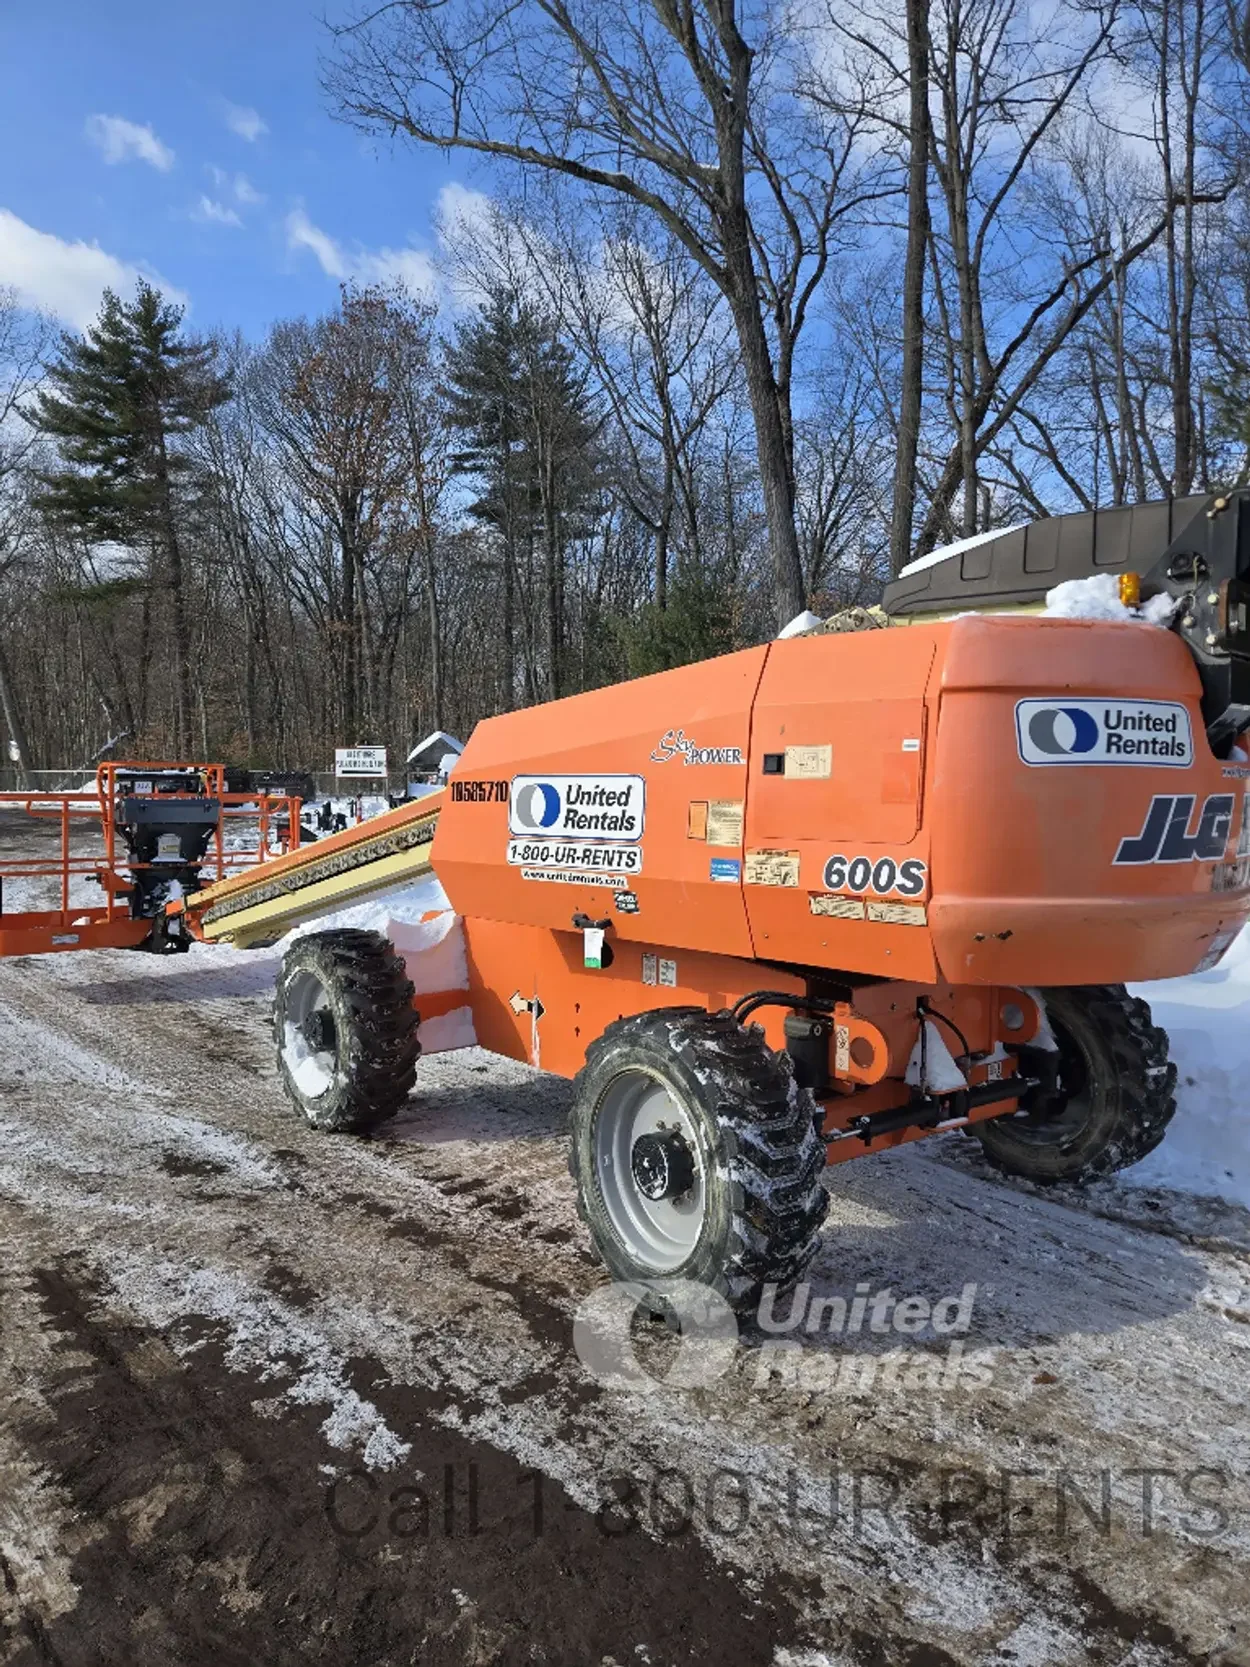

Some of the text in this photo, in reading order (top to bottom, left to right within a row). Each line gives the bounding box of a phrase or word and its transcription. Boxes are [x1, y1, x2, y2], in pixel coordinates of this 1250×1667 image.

[1104, 709, 1177, 733] United
[691, 748, 742, 764] POWER
[1105, 733, 1186, 758] Rentals
[451, 781, 509, 802] 10585710
[566, 784, 632, 807] United
[563, 808, 636, 832] Rentals
[1112, 793, 1235, 865] JLG
[510, 844, 638, 868] 1-800-UR-RENTS
[824, 855, 927, 895] 600S
